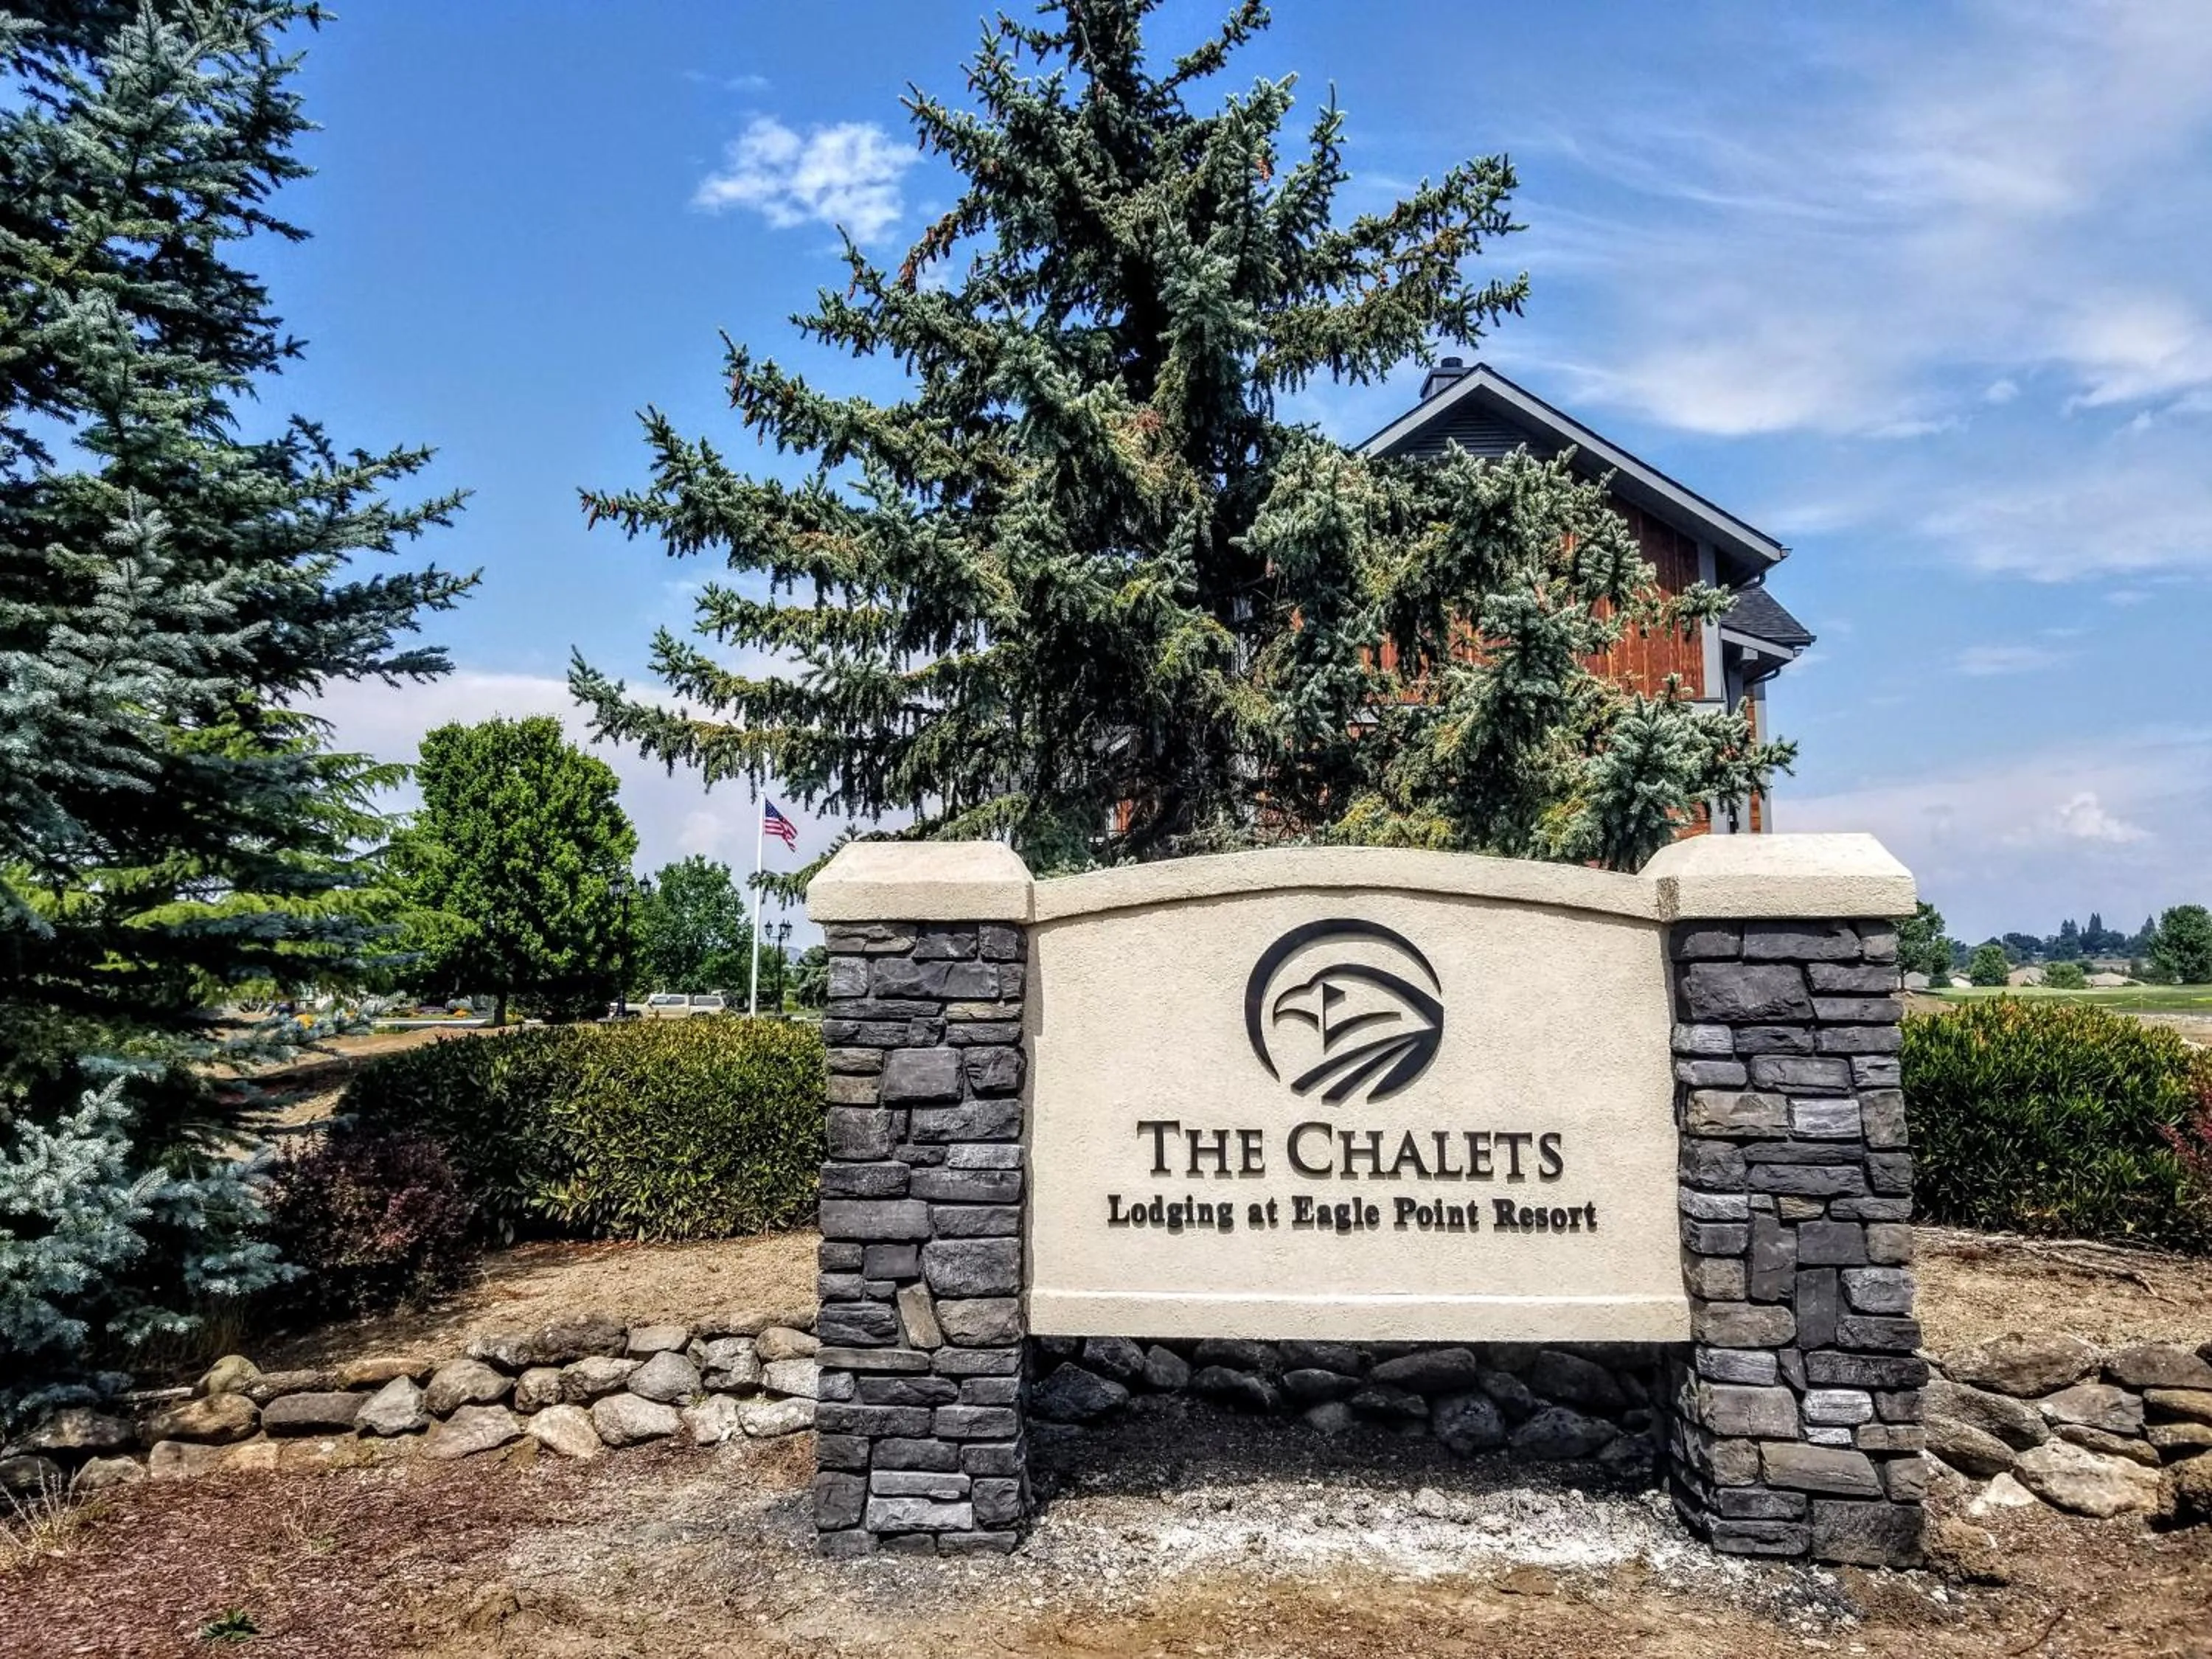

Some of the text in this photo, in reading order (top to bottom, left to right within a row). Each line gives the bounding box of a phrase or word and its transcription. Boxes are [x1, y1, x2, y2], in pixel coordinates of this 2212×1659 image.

[1136, 1119, 1565, 1182] THE CHALETS
[1106, 1194, 1598, 1234] Lodging at Eagle Point Resort
